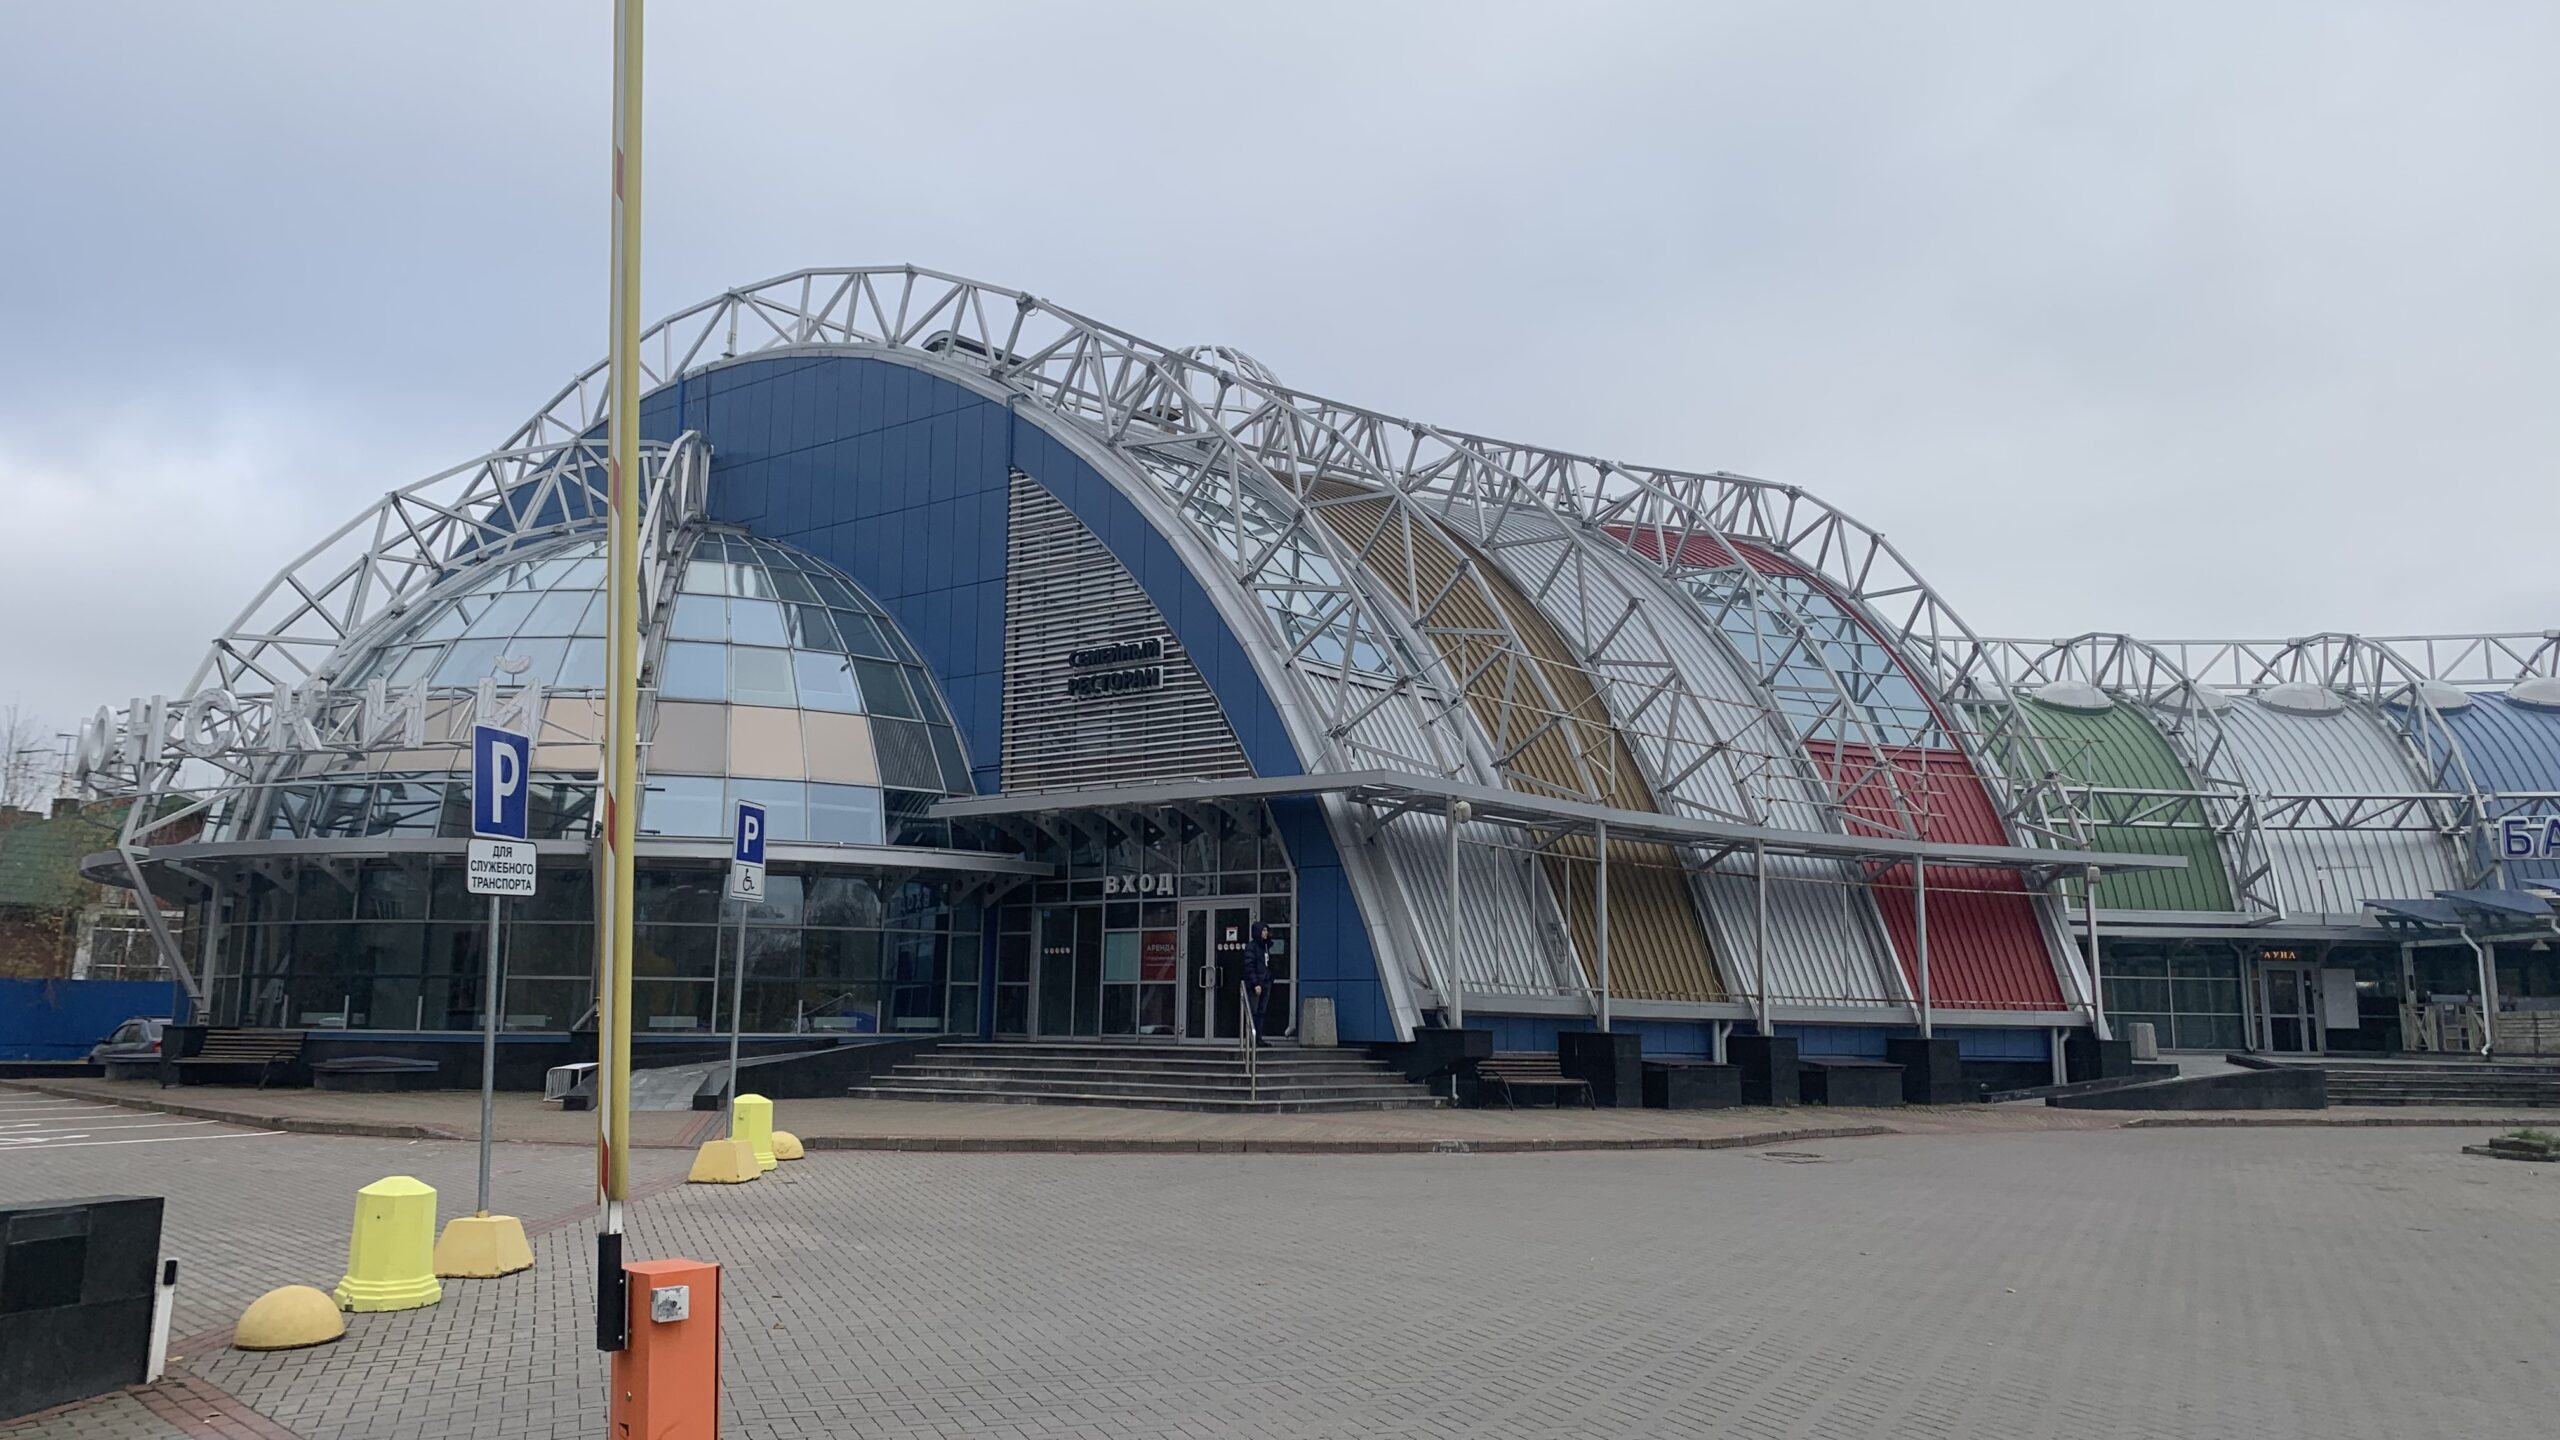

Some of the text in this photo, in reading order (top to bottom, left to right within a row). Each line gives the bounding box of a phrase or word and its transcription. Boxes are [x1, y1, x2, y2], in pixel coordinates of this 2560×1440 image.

[1068, 666, 1163, 699] РЕСТОРАН
[75, 655, 541, 780] ОНСКИЙ
[492, 741, 519, 823] P
[743, 815, 759, 853] P
[492, 845, 513, 859] ДЛЯ
[470, 860, 534, 875] СЛУЖЕБНОГО
[472, 875, 532, 891] ТРАНСПОРТА
[1105, 873, 1175, 896] ВХОД
[1146, 943, 1175, 953] АРЕНДА
[2260, 951, 2297, 960] АУНА
